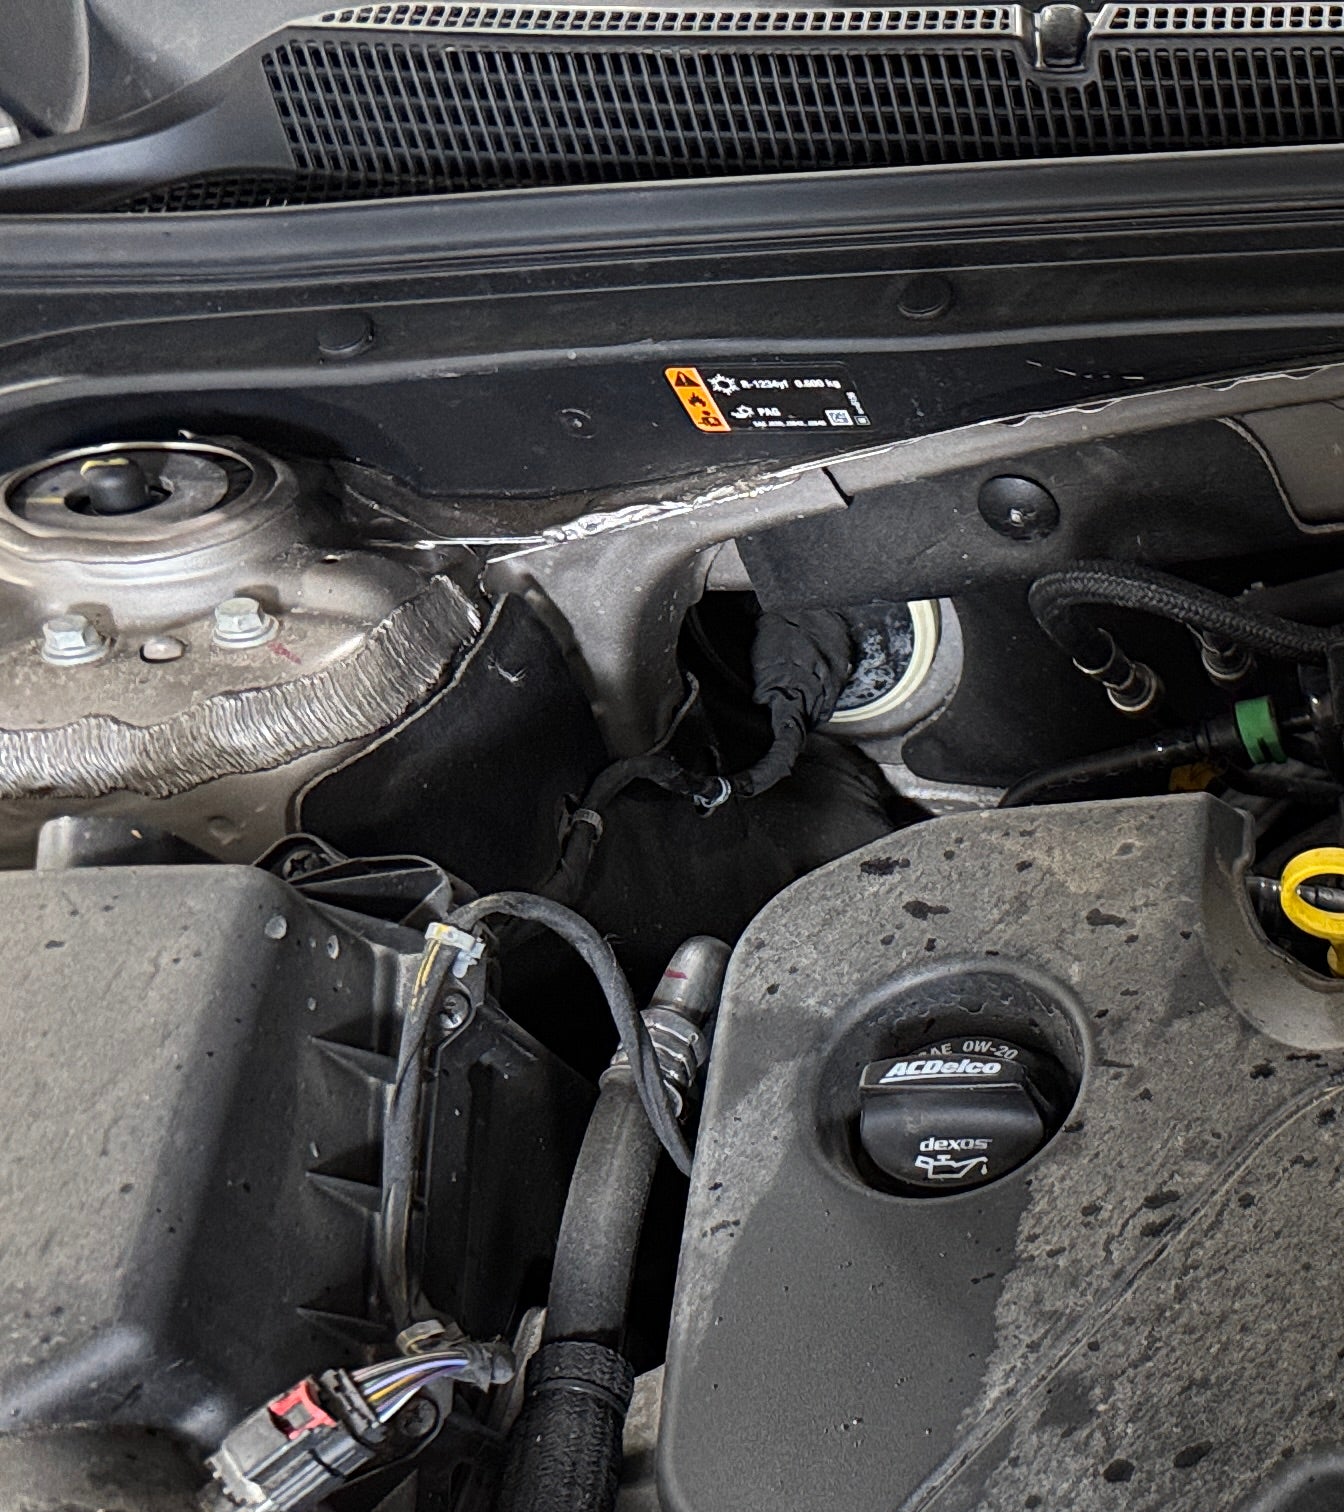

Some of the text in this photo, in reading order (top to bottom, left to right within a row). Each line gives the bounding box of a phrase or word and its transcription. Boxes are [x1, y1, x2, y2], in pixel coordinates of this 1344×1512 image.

[962, 1040, 1019, 1060] 0W-20
[886, 1058, 1002, 1077] ACDelco
[920, 1136, 989, 1151] dexos
